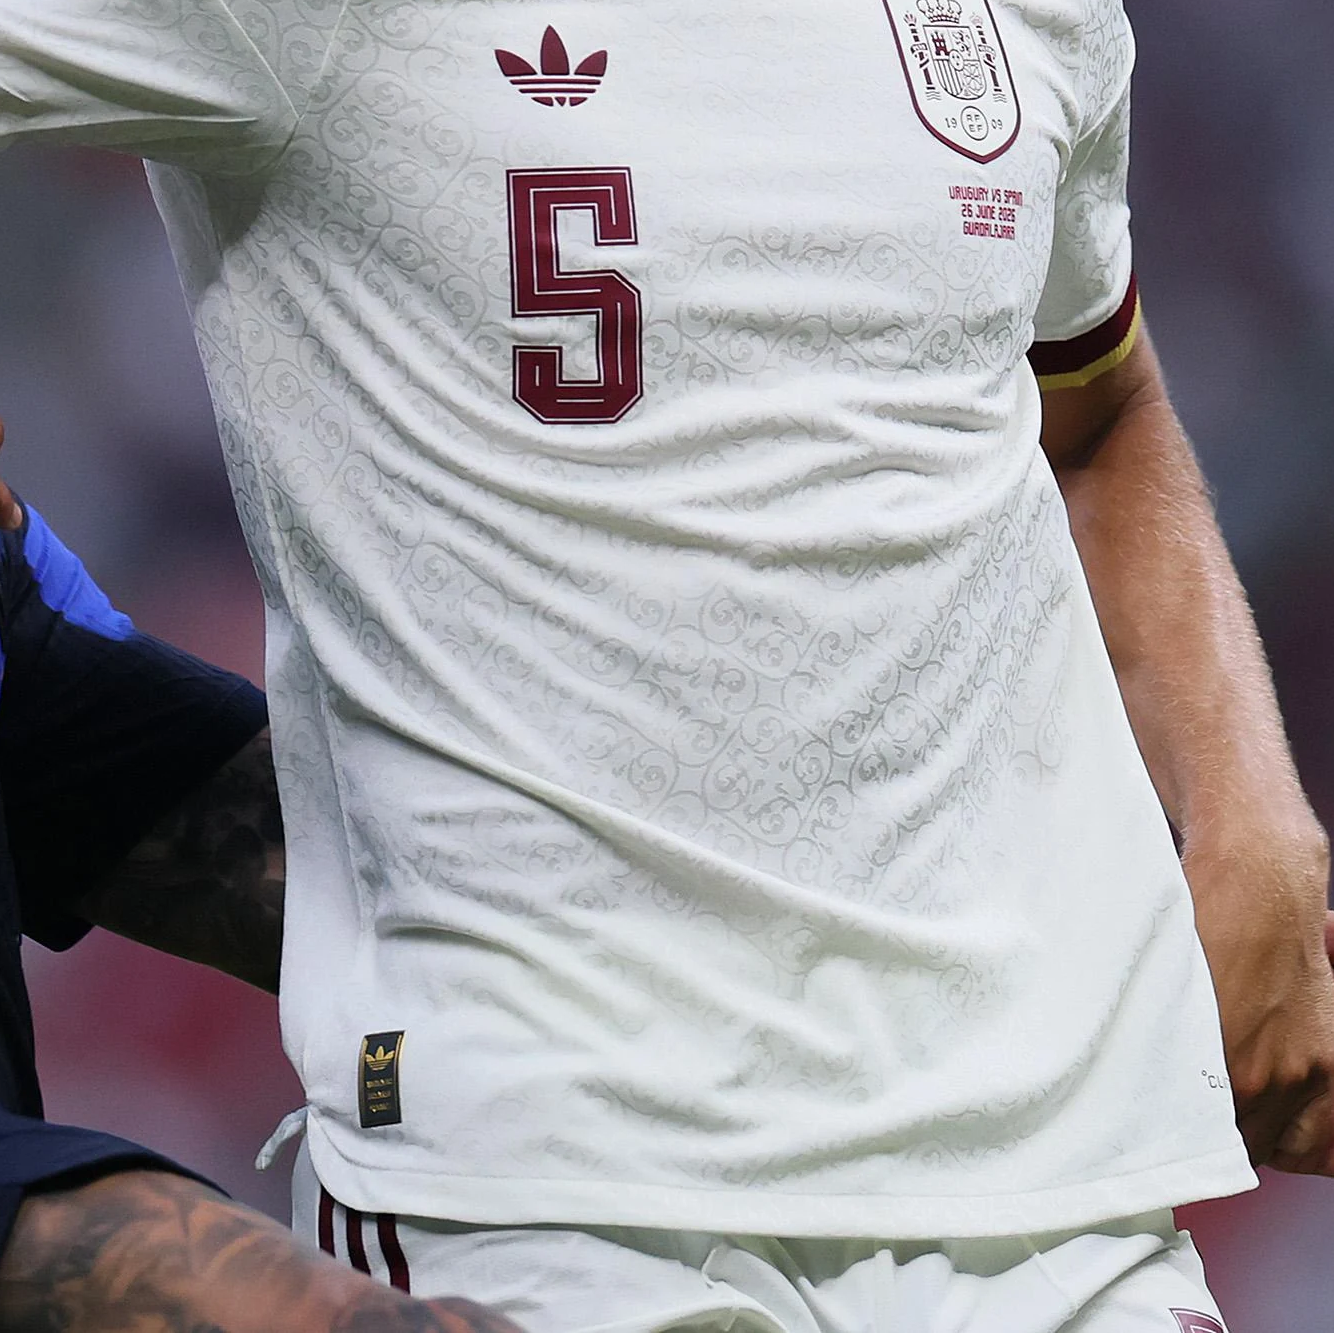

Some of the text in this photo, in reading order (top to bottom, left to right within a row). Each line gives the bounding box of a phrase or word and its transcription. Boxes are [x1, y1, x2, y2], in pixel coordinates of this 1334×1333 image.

[945, 117, 957, 128] 19
[991, 118, 1003, 130] 09
[948, 186, 1024, 207] URUGUAY VS SPAIN
[961, 203, 1016, 222] 26 JUNE 2026
[963, 221, 1016, 241] GUADALAJARA
[506, 167, 643, 425] 5
